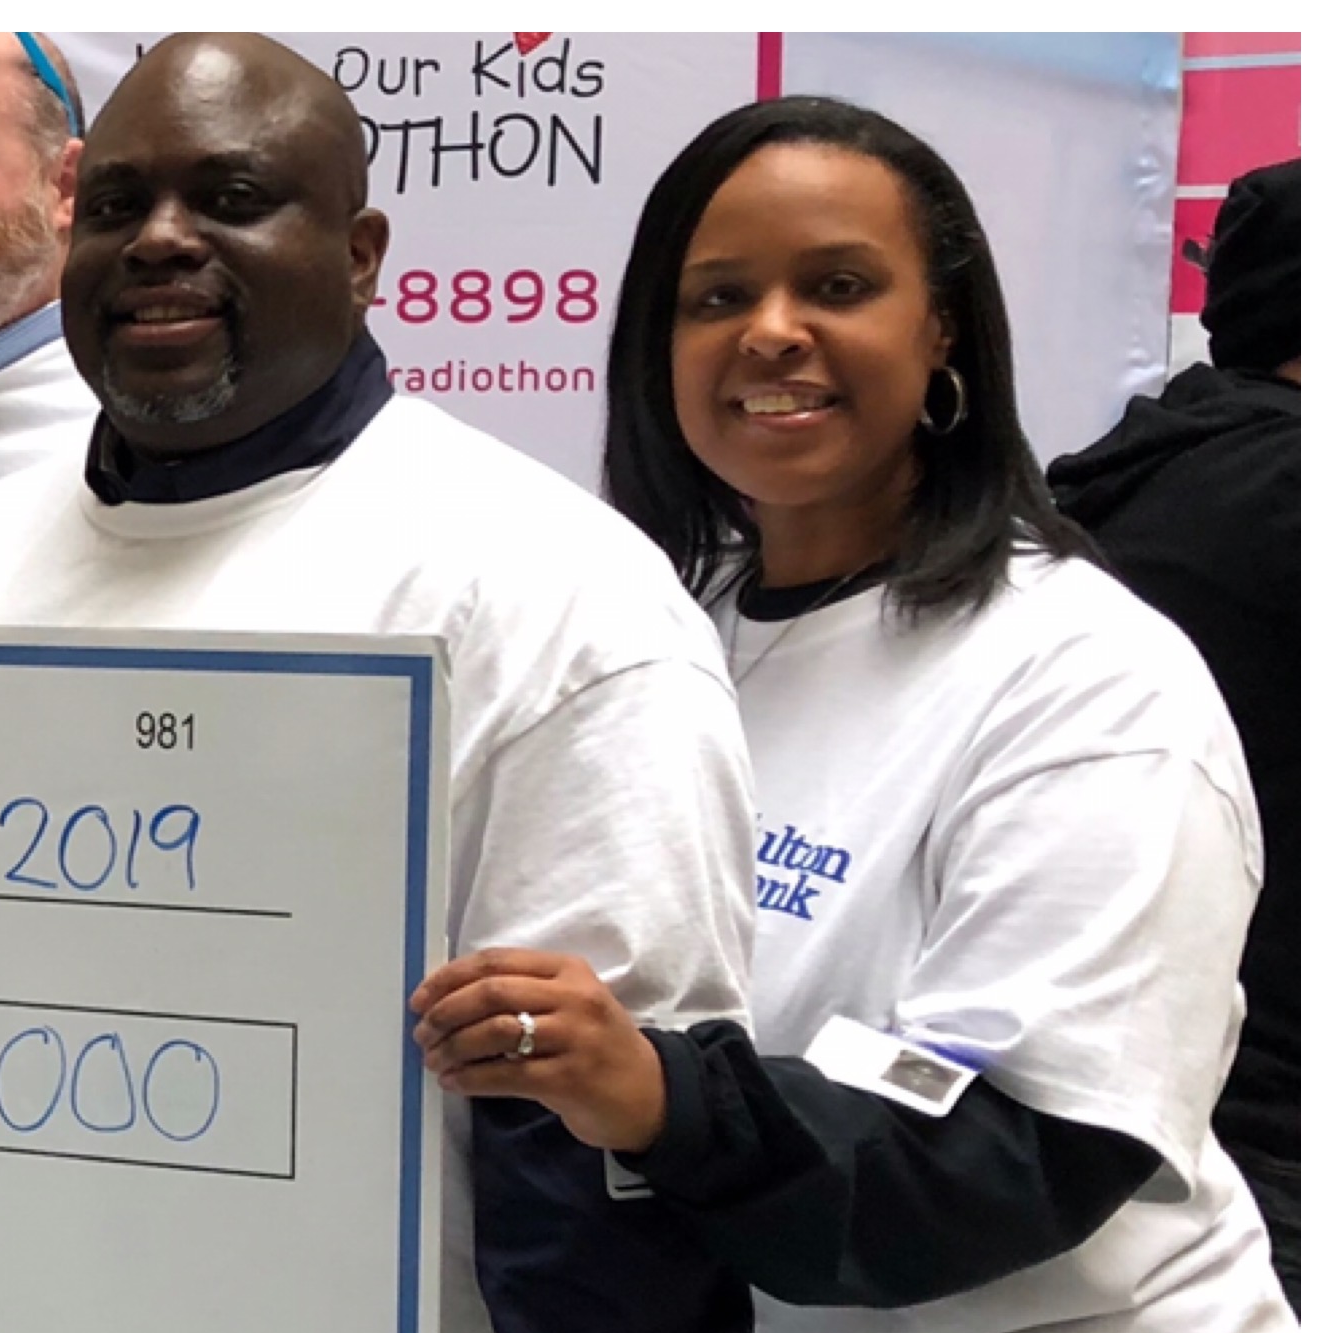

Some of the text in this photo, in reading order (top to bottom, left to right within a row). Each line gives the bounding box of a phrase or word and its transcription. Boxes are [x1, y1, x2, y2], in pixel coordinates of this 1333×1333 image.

[334, 39, 605, 98] Our Kids
[135, 712, 198, 752] 981
[757, 824, 852, 884] ulton
